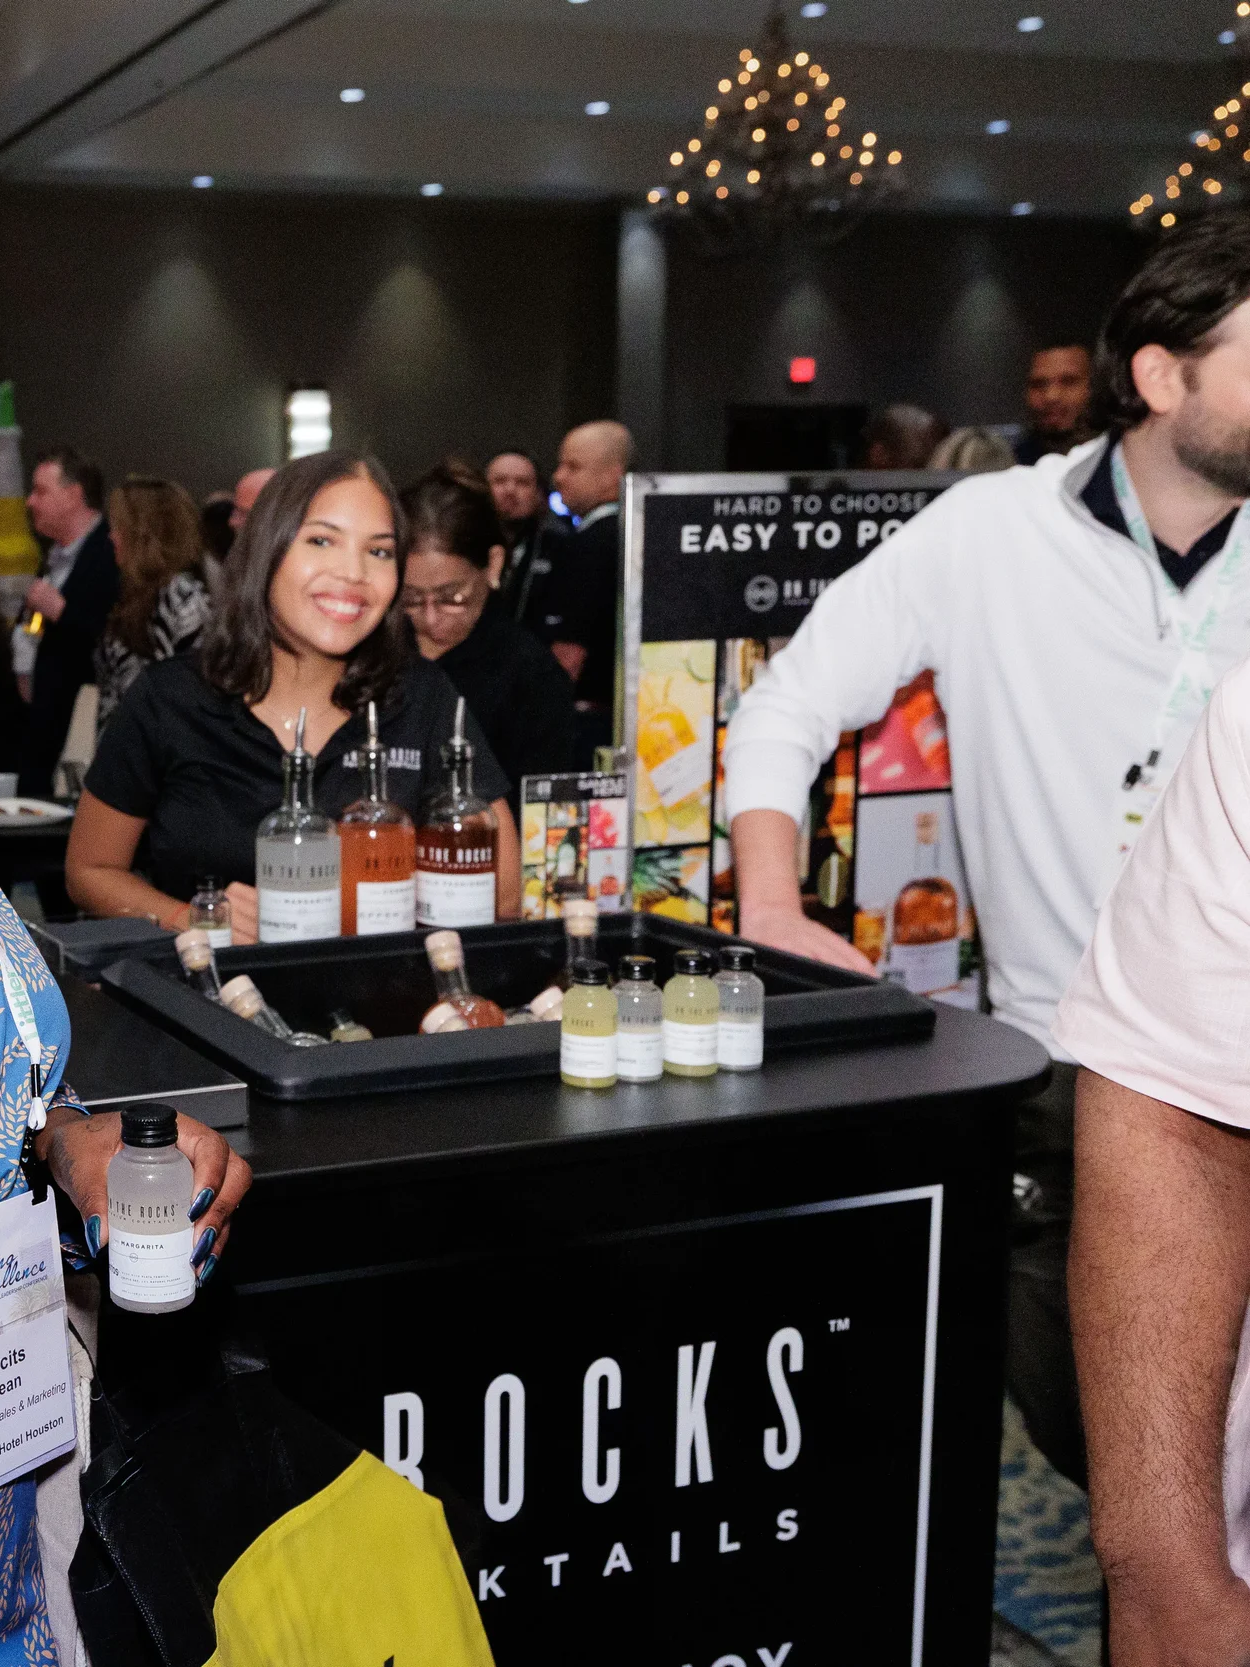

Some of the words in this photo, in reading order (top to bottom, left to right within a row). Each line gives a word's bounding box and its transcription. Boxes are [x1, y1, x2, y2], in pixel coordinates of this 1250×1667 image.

[713, 496, 782, 516] HARD
[791, 494, 822, 515] TO
[680, 522, 778, 553] EASY
[792, 520, 842, 550] TO
[116, 1201, 132, 1217] THE
[140, 1203, 175, 1219] ROCKS
[121, 1241, 165, 1250] MARGARITA
[0, 1285, 23, 1300] LEADERSHIP
[23, 1274, 48, 1290] CONFERENCE
[19, 1400, 25, 1411] &
[27, 1381, 67, 1407] Marketing
[25, 1416, 64, 1440] Houston
[478, 1508, 799, 1601] KTAILS
